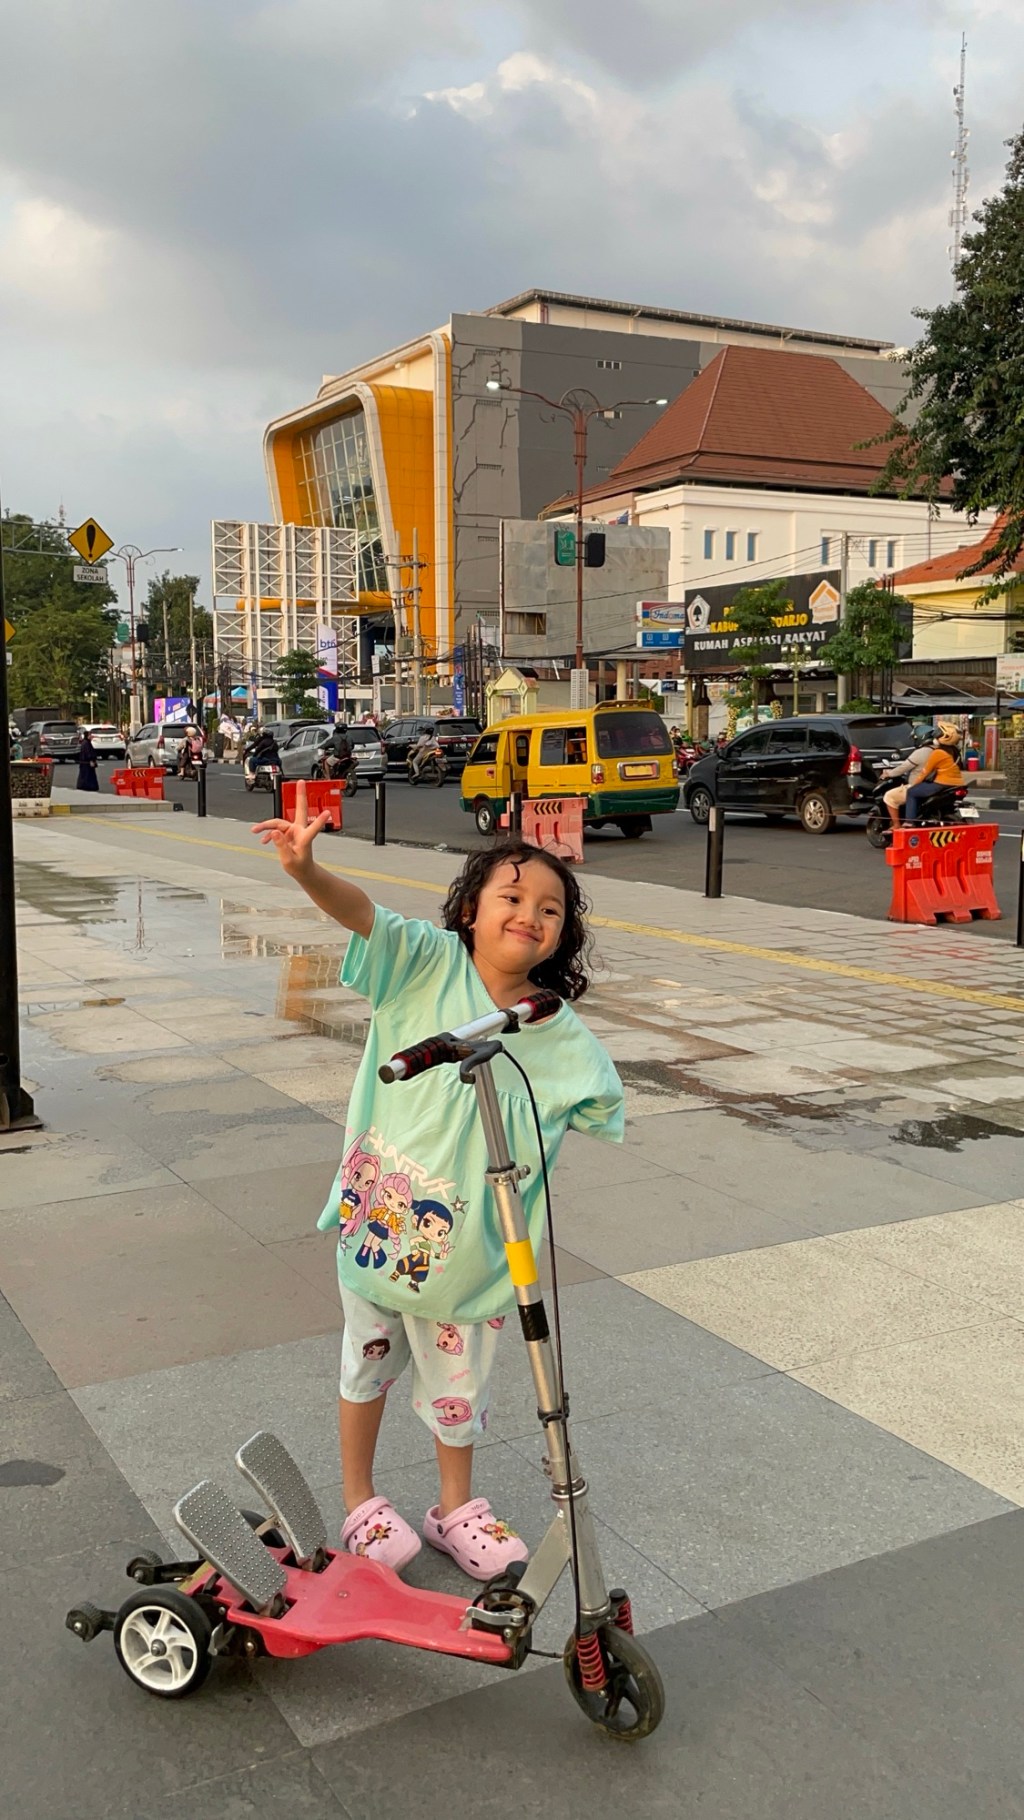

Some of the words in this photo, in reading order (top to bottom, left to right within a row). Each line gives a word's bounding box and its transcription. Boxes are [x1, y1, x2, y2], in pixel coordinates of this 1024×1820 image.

[77, 574, 104, 582] SEKOLAH
[694, 639, 728, 651] RUMAH
[784, 630, 827, 645] RAKYAT
